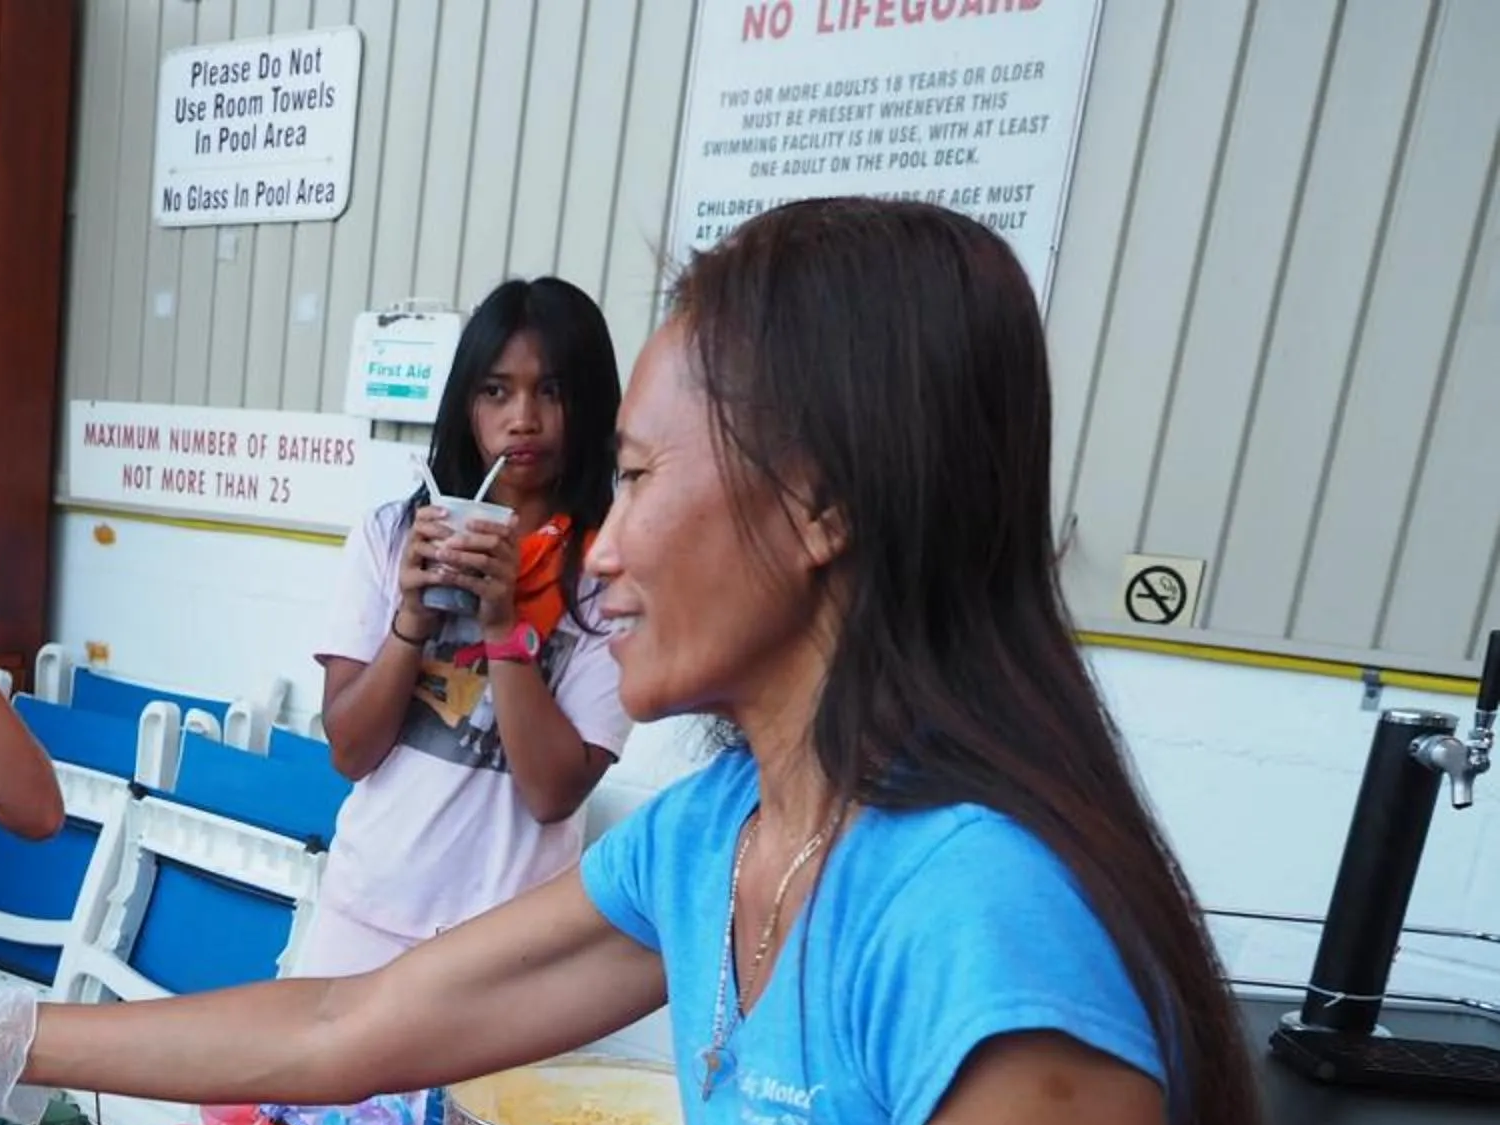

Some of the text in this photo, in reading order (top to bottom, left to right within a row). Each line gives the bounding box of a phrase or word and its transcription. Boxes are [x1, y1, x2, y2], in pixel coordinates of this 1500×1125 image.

[742, 1, 794, 42] NO
[191, 47, 322, 88] Please Do Not
[720, 61, 1046, 108] TWO OR MORE ADULTS 18 YEARS OR OLDER
[175, 81, 335, 124] Use Room Towels
[742, 92, 1008, 130] MUST BE PRESENT WHENEVER THIS
[195, 123, 307, 154] In Pool Area
[703, 135, 777, 157] SWIMMING
[781, 129, 845, 151] FACILITY
[849, 129, 863, 147] IS
[868, 127, 884, 146] IN
[929, 121, 969, 142] WITH
[973, 119, 994, 139] AT
[998, 114, 1050, 136] LEAST
[750, 147, 979, 178] ONE ADULT ON THE POOL DECK.
[163, 178, 335, 212] No Glass In Pool Area
[698, 198, 763, 217] CHILDREN
[950, 186, 981, 207] AGE
[986, 183, 1035, 205] MUST
[696, 224, 711, 240] AT
[369, 362, 432, 380] First Aid
[84, 422, 356, 466] MAXIMUM NUMBER OF BATHERS
[122, 464, 291, 503] NOT MORE THAN 25
